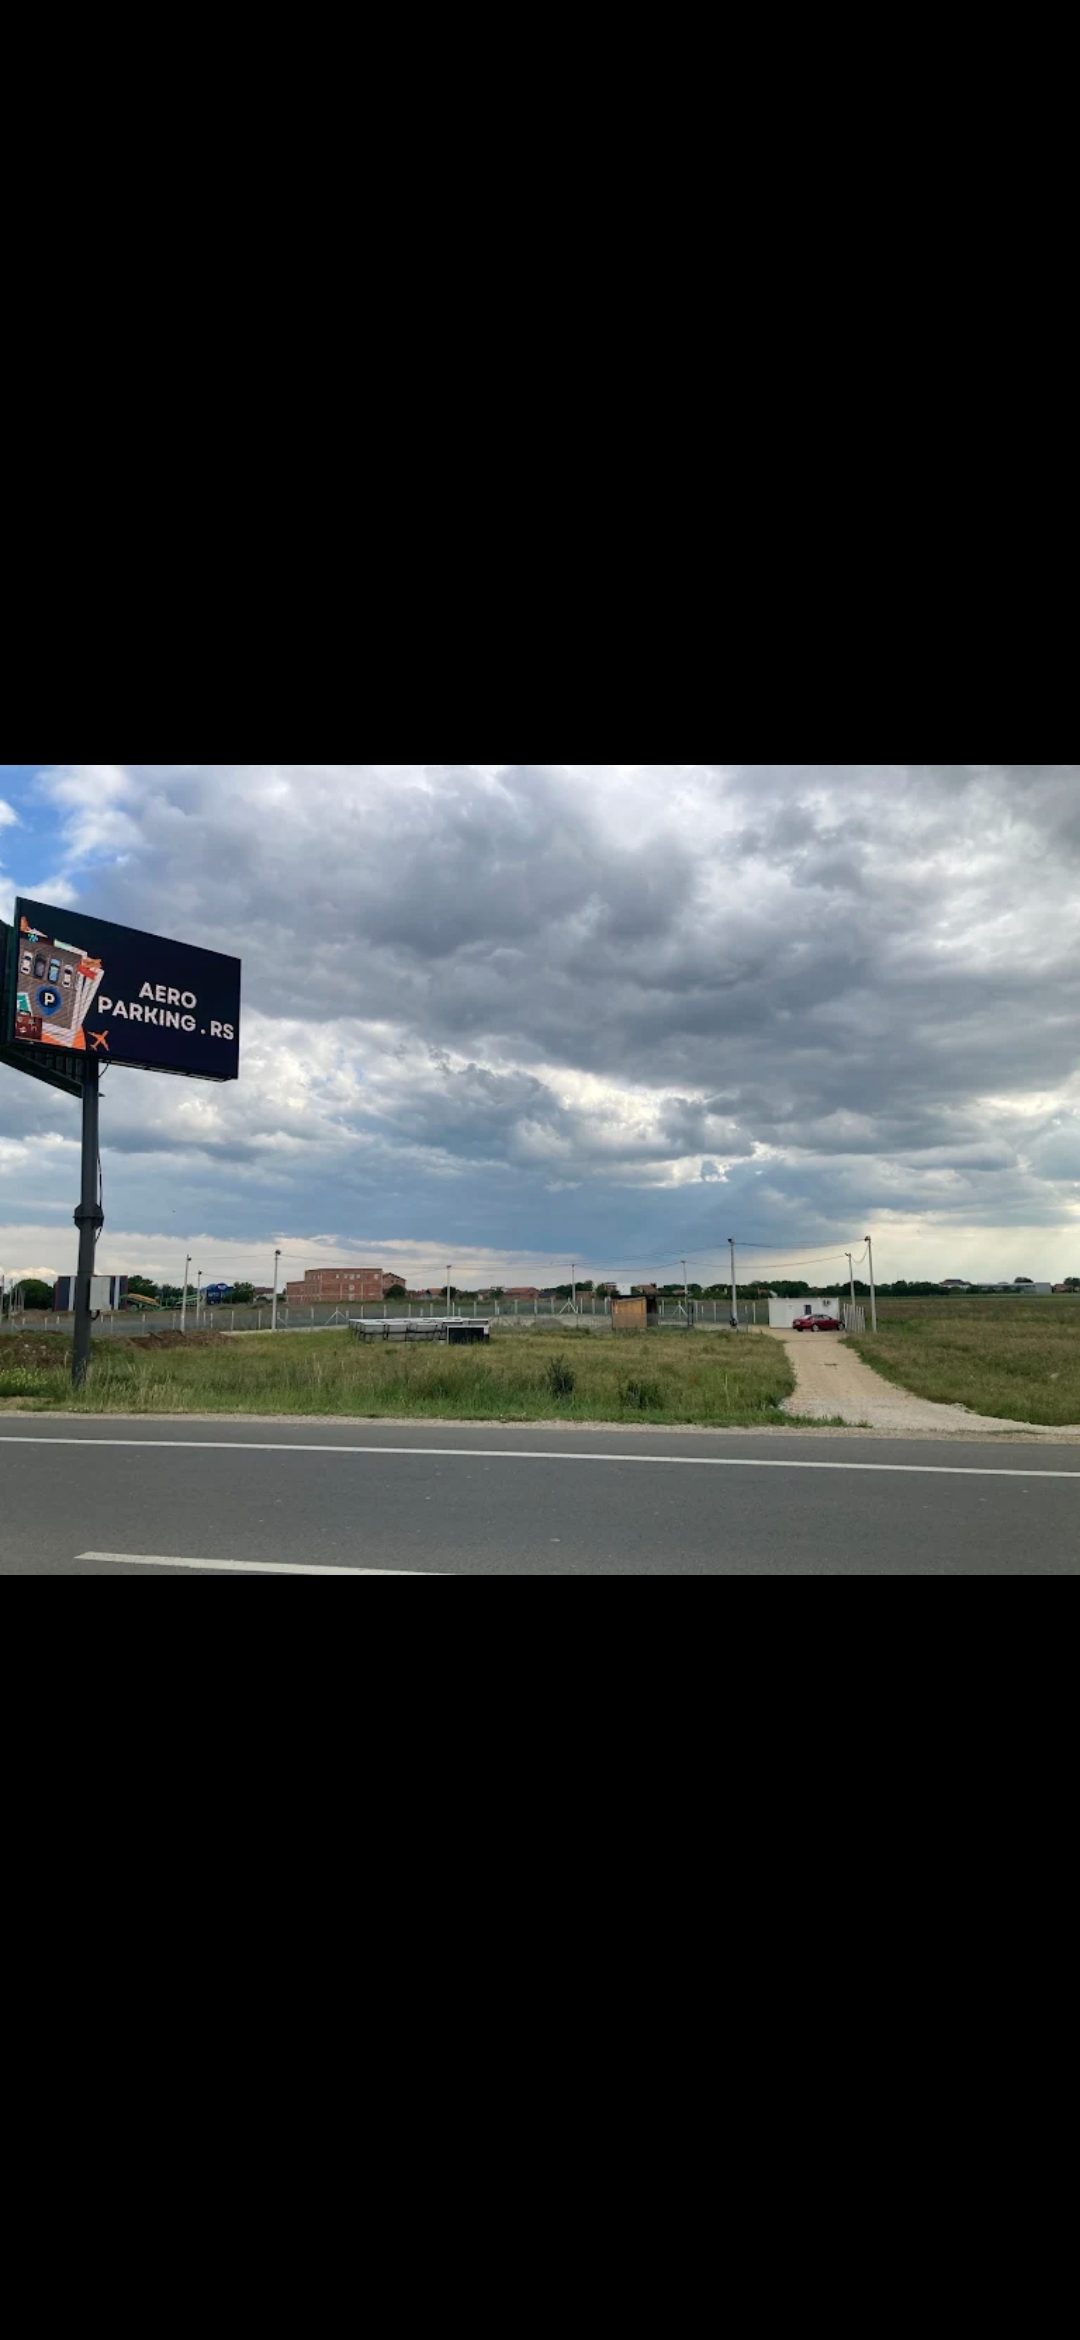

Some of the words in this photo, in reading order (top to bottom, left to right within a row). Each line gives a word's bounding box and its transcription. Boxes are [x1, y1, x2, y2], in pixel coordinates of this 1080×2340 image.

[44, 993, 54, 1006] P
[139, 982, 198, 1009] AERO
[97, 996, 197, 1031] PARKING
